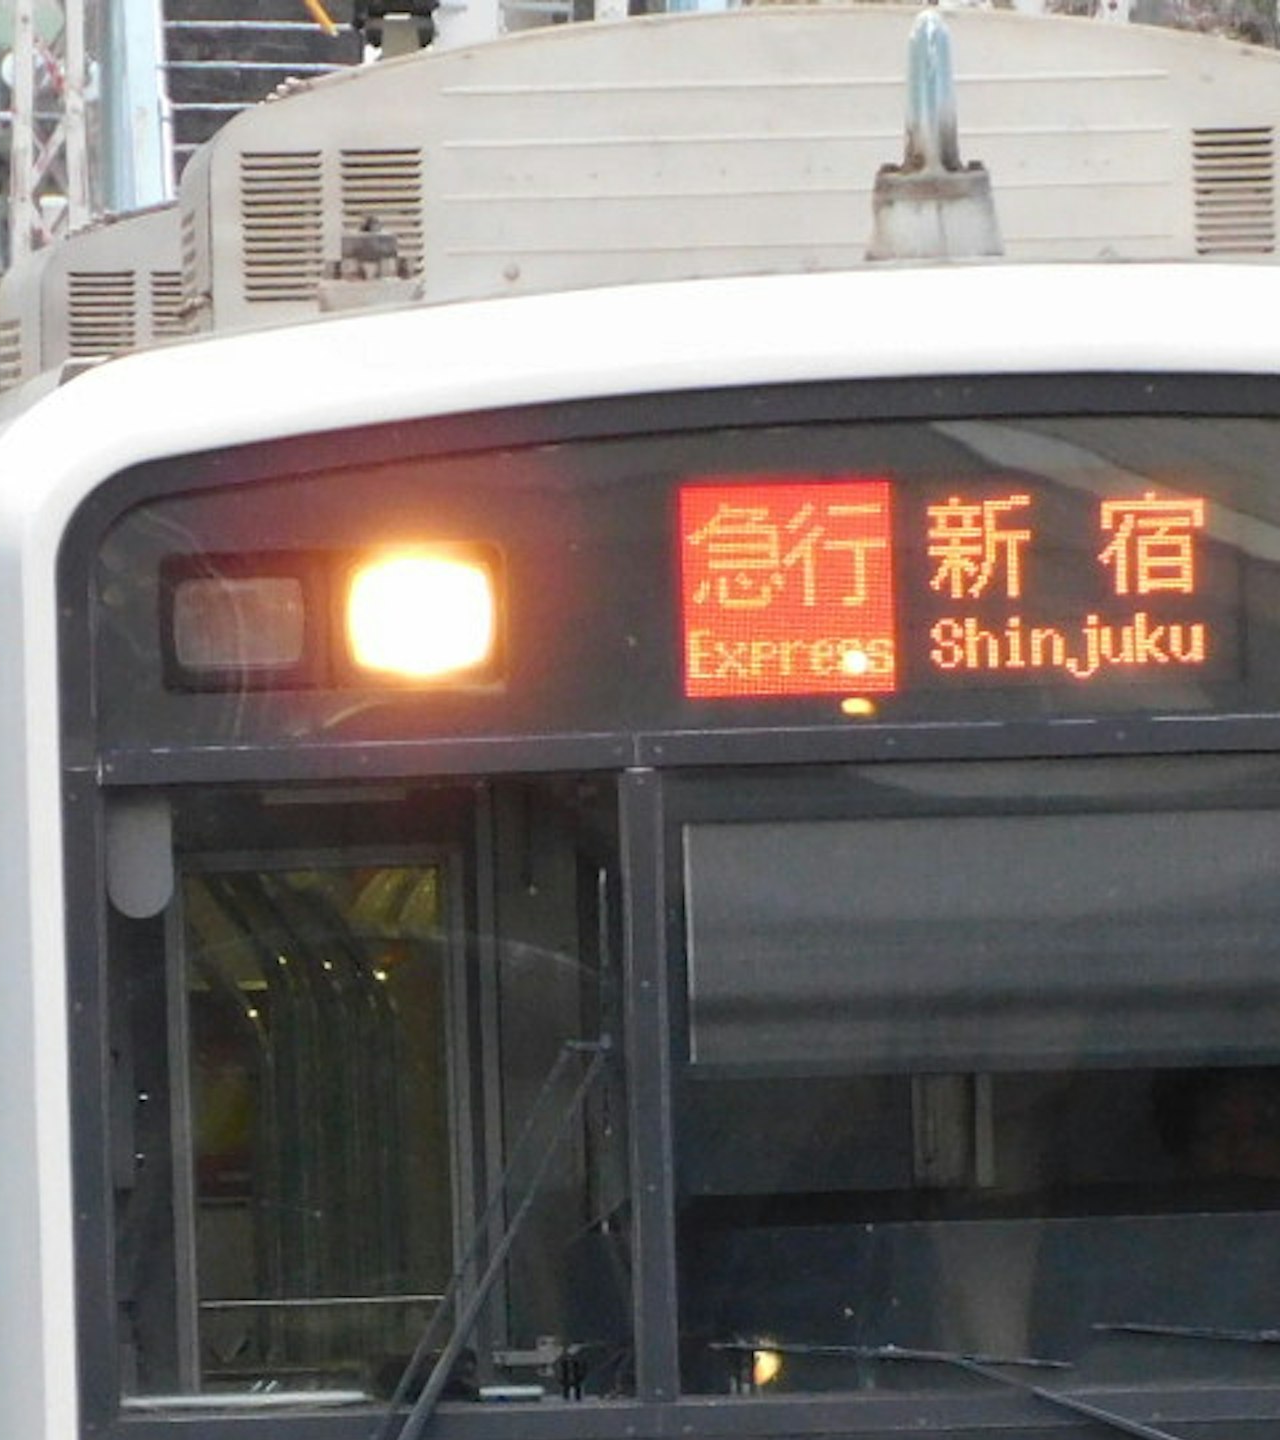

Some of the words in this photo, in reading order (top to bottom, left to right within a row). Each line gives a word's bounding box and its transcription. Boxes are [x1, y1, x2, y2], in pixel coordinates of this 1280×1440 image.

[686, 502, 888, 607] 急行
[927, 492, 1205, 598] 新宿
[930, 613, 1205, 679] Shinjuku
